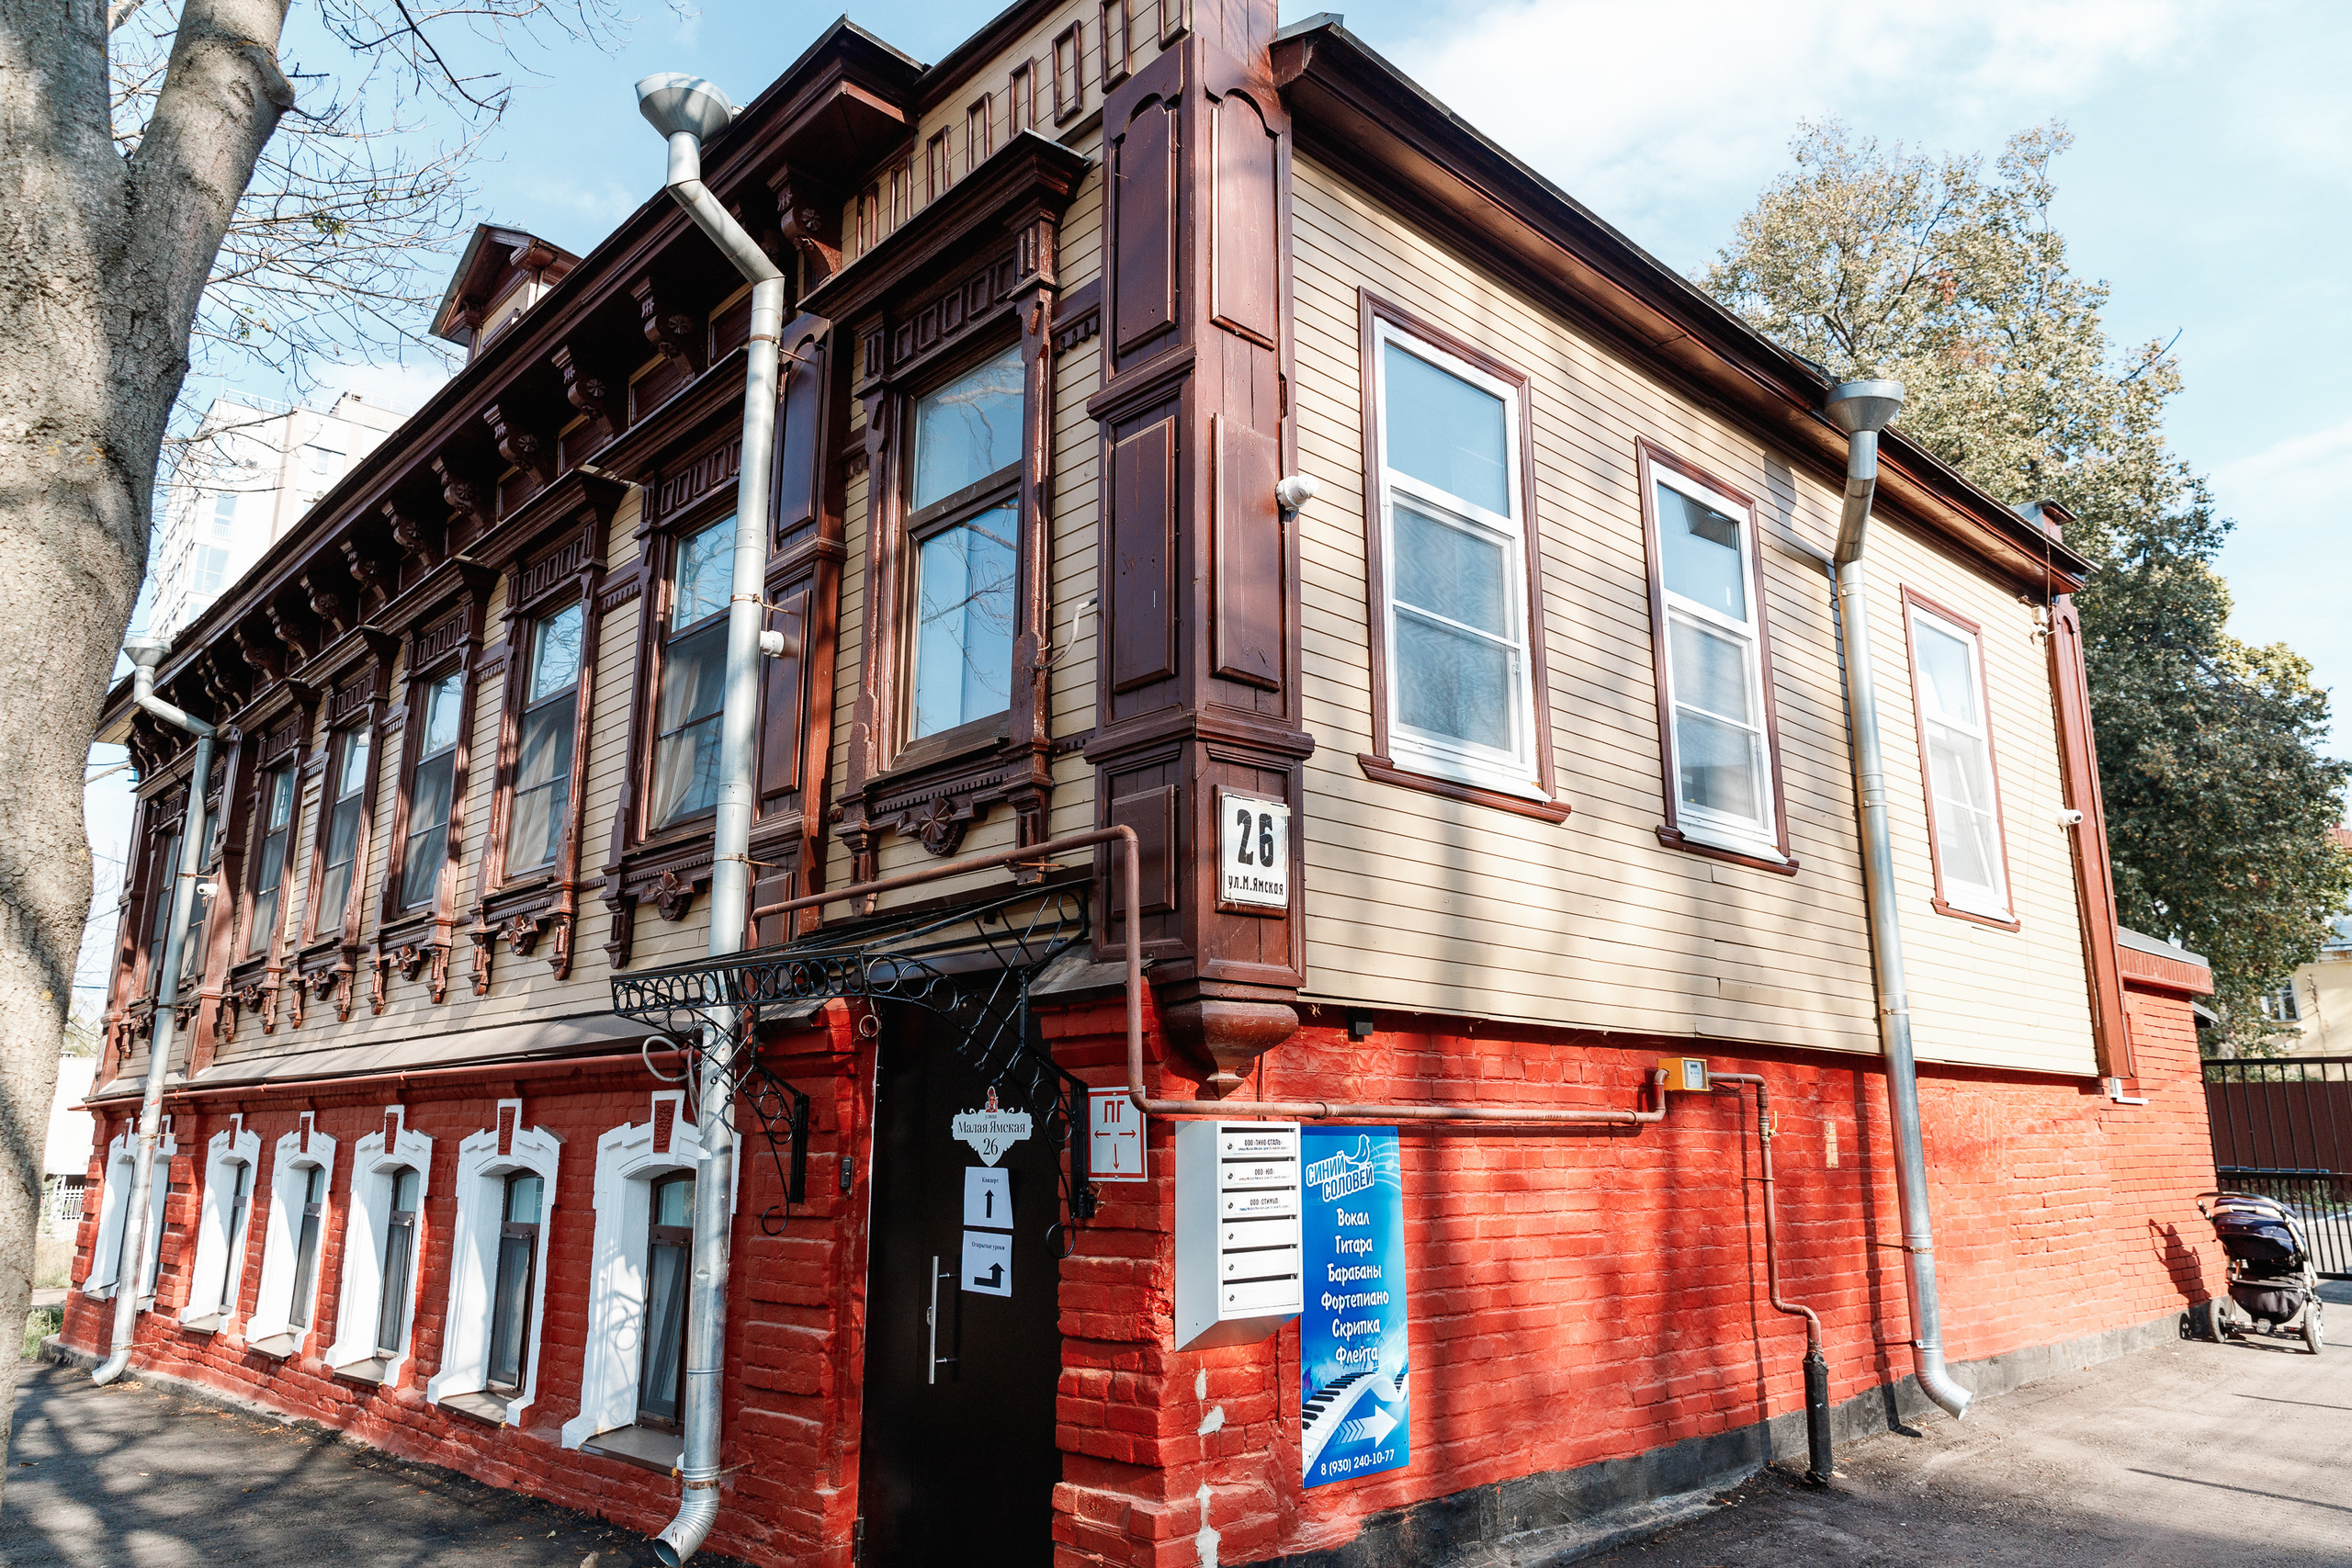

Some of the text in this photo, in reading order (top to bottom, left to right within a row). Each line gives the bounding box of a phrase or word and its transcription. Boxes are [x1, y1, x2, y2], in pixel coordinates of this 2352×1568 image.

[1237, 808, 1274, 868] 26
[1104, 1100, 1125, 1122] ПГ
[957, 1121, 1025, 1134] Малая Ямская
[982, 1137, 999, 1155] 26
[1306, 1151, 1345, 1185] СИНИЙ
[1323, 1163, 1374, 1201] СОЛОВЕЙ
[1336, 1208, 1370, 1226] Вокал
[971, 1240, 992, 1249] Открытые
[1335, 1235, 1374, 1258] Гитара
[1327, 1263, 1382, 1286] Барабаны
[1321, 1291, 1389, 1314] Фортепиано
[1332, 1318, 1380, 1341] Скрипка
[1335, 1346, 1378, 1365] Флейта
[1320, 1449, 1395, 1476] 8 (930) 240-10-77
